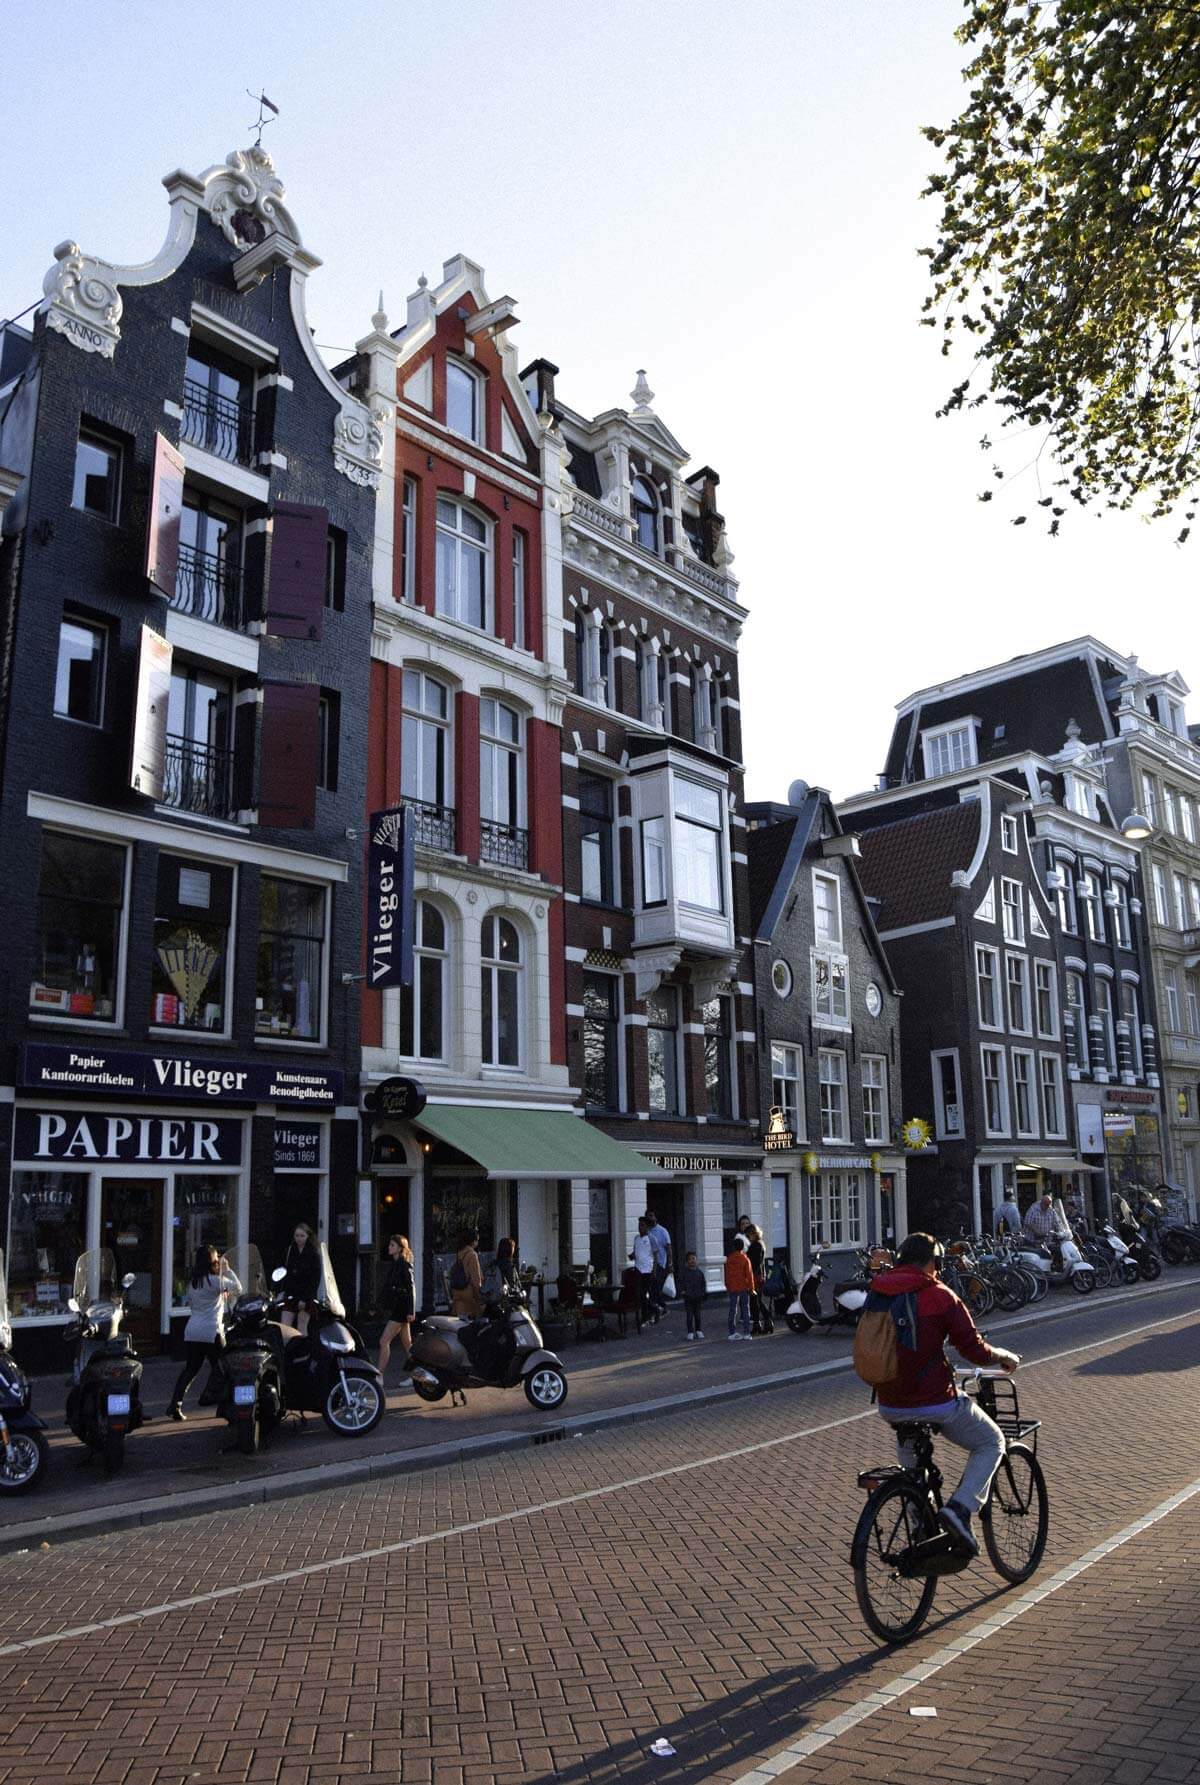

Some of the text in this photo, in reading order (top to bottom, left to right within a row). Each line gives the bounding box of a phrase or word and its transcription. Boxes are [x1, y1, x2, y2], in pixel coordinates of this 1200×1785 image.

[63, 319, 102, 346] ANNO
[372, 860, 399, 983] Vlieger
[69, 1054, 106, 1070] Papier
[41, 1067, 134, 1087] Kantoorartikelen
[152, 1058, 248, 1095] Vlieger
[276, 1071, 328, 1086] Kunstenaars
[269, 1084, 334, 1100] Benodigdheden
[33, 1113, 223, 1160] PAPIER
[273, 1130, 319, 1148] Vlieger
[764, 1140, 793, 1151] HOTEL
[274, 1150, 316, 1162] Sinds 1869
[663, 1156, 688, 1169] BIRD
[689, 1157, 722, 1170] HOTEL
